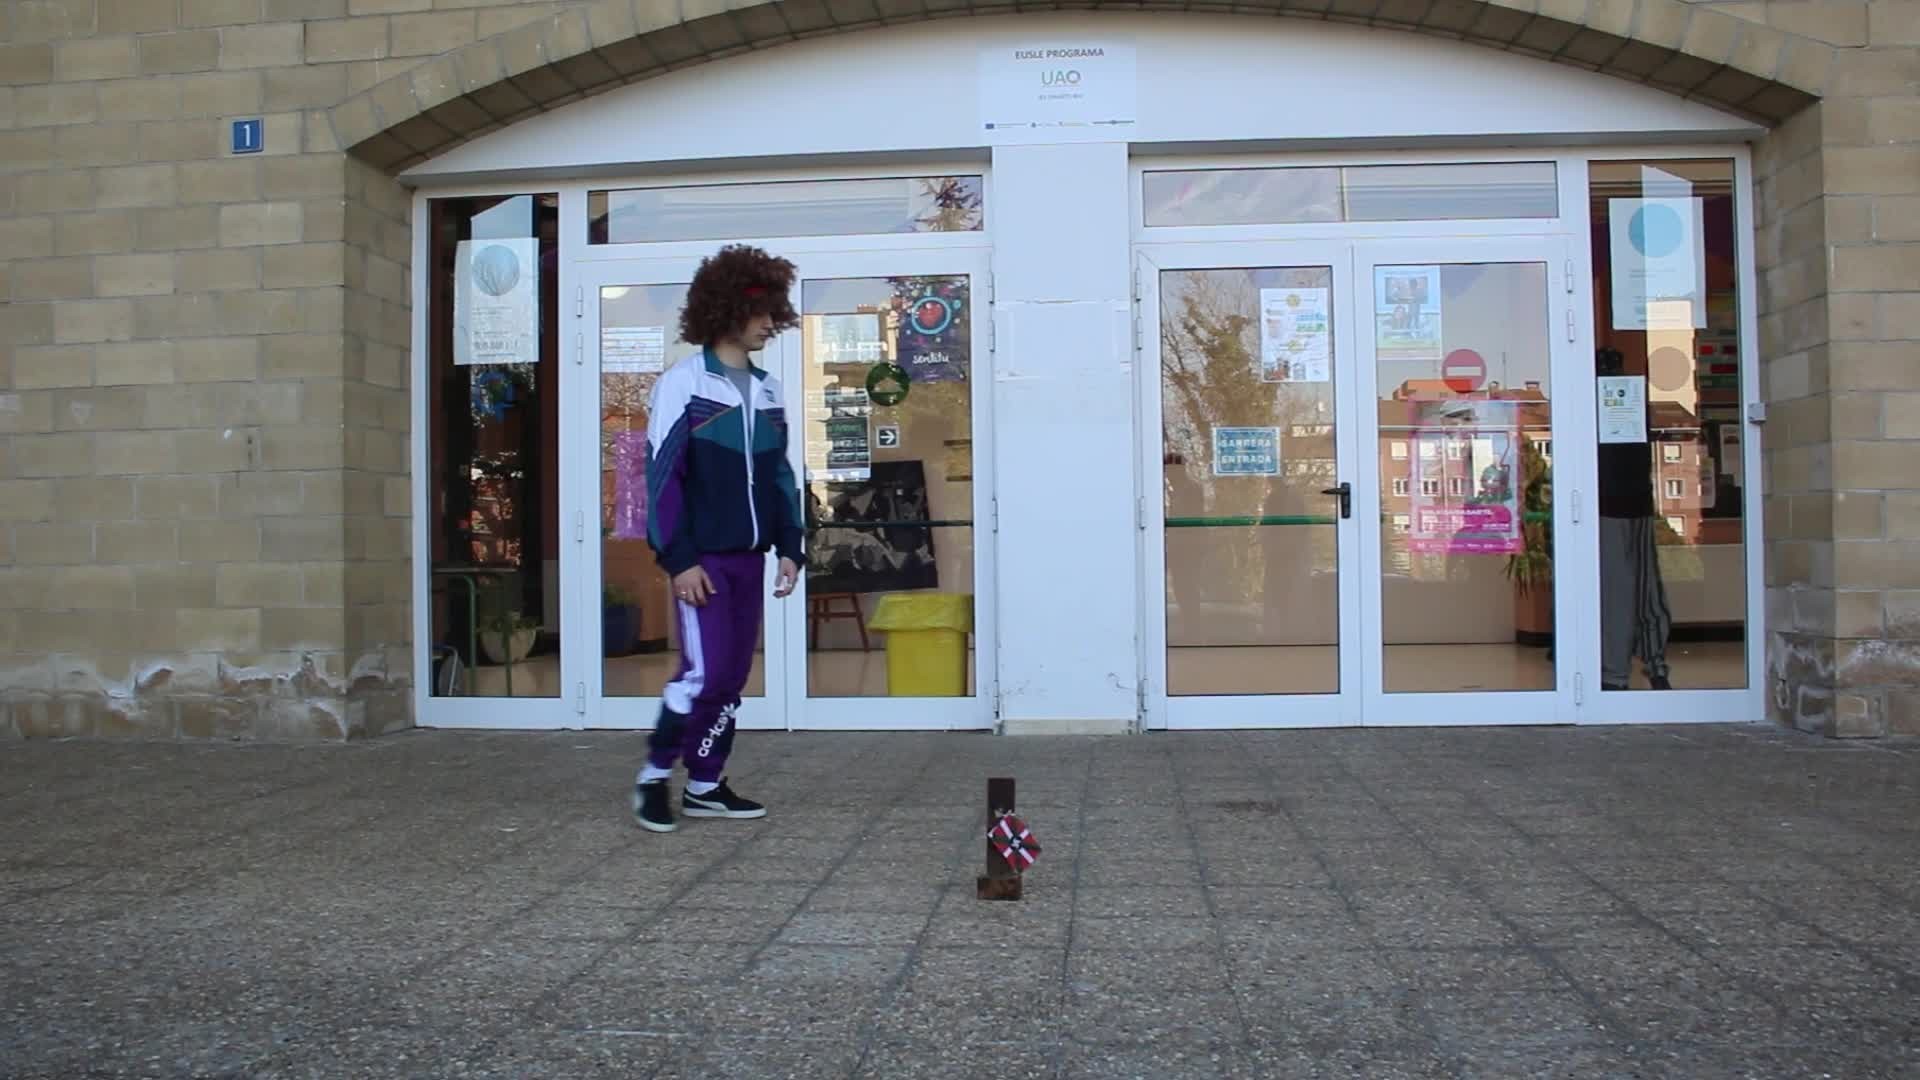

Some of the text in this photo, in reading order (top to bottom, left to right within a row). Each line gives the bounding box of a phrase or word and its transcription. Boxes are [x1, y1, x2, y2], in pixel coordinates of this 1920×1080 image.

[1015, 48, 1104, 59] EUSLE PROGRAMA
[243, 124, 250, 147] 1
[1221, 439, 1272, 448] SARRERA
[1221, 455, 1272, 465] ENTRADA
